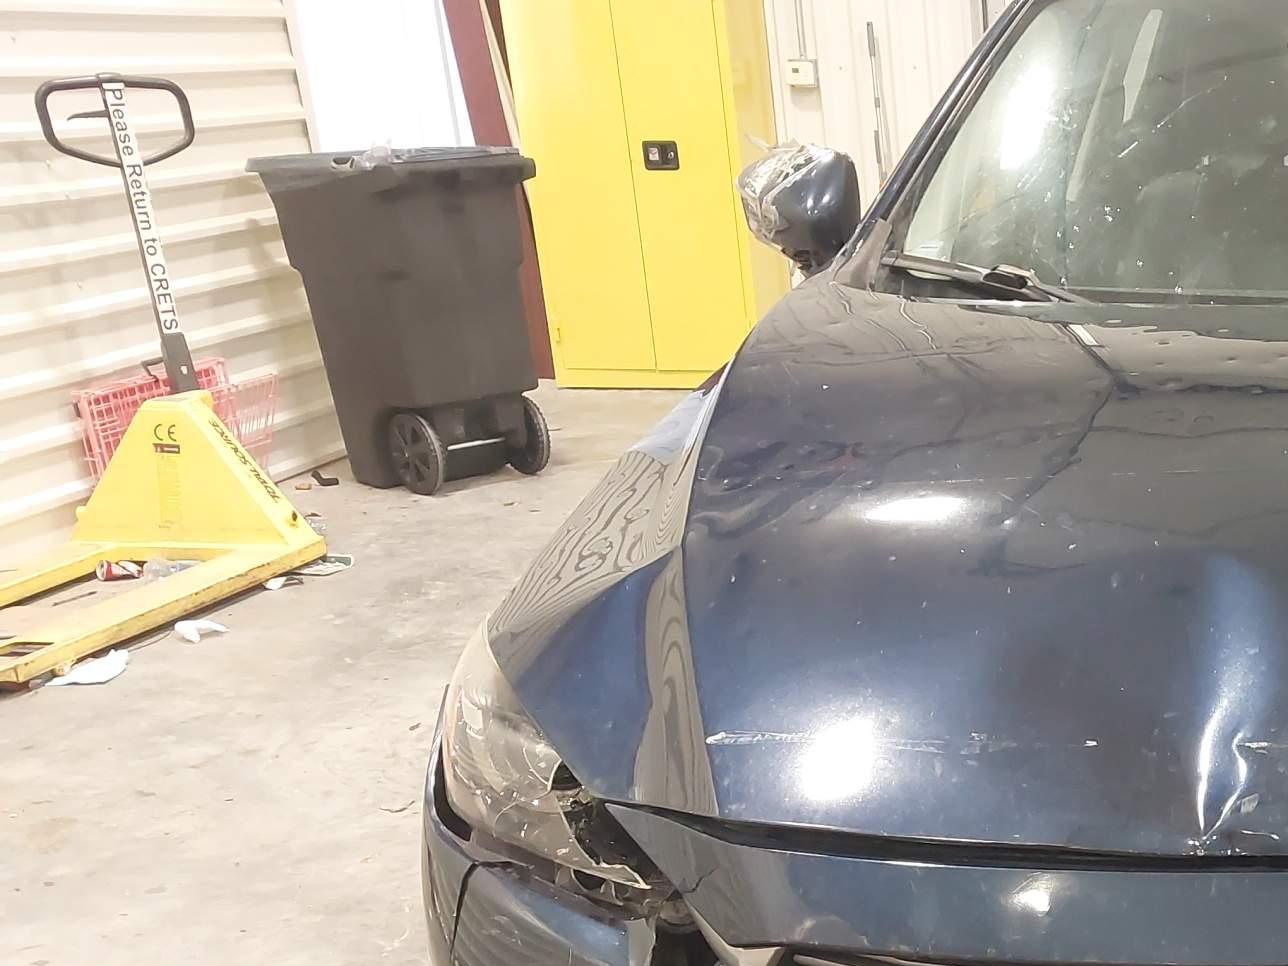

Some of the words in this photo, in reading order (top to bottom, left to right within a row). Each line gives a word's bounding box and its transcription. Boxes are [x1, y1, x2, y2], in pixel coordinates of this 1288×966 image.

[109, 88, 134, 156] Please
[126, 164, 151, 231] Return
[144, 237, 158, 257] to
[151, 263, 178, 331] CRETS
[153, 423, 177, 442] CE
[208, 418, 249, 466] SOURCE
